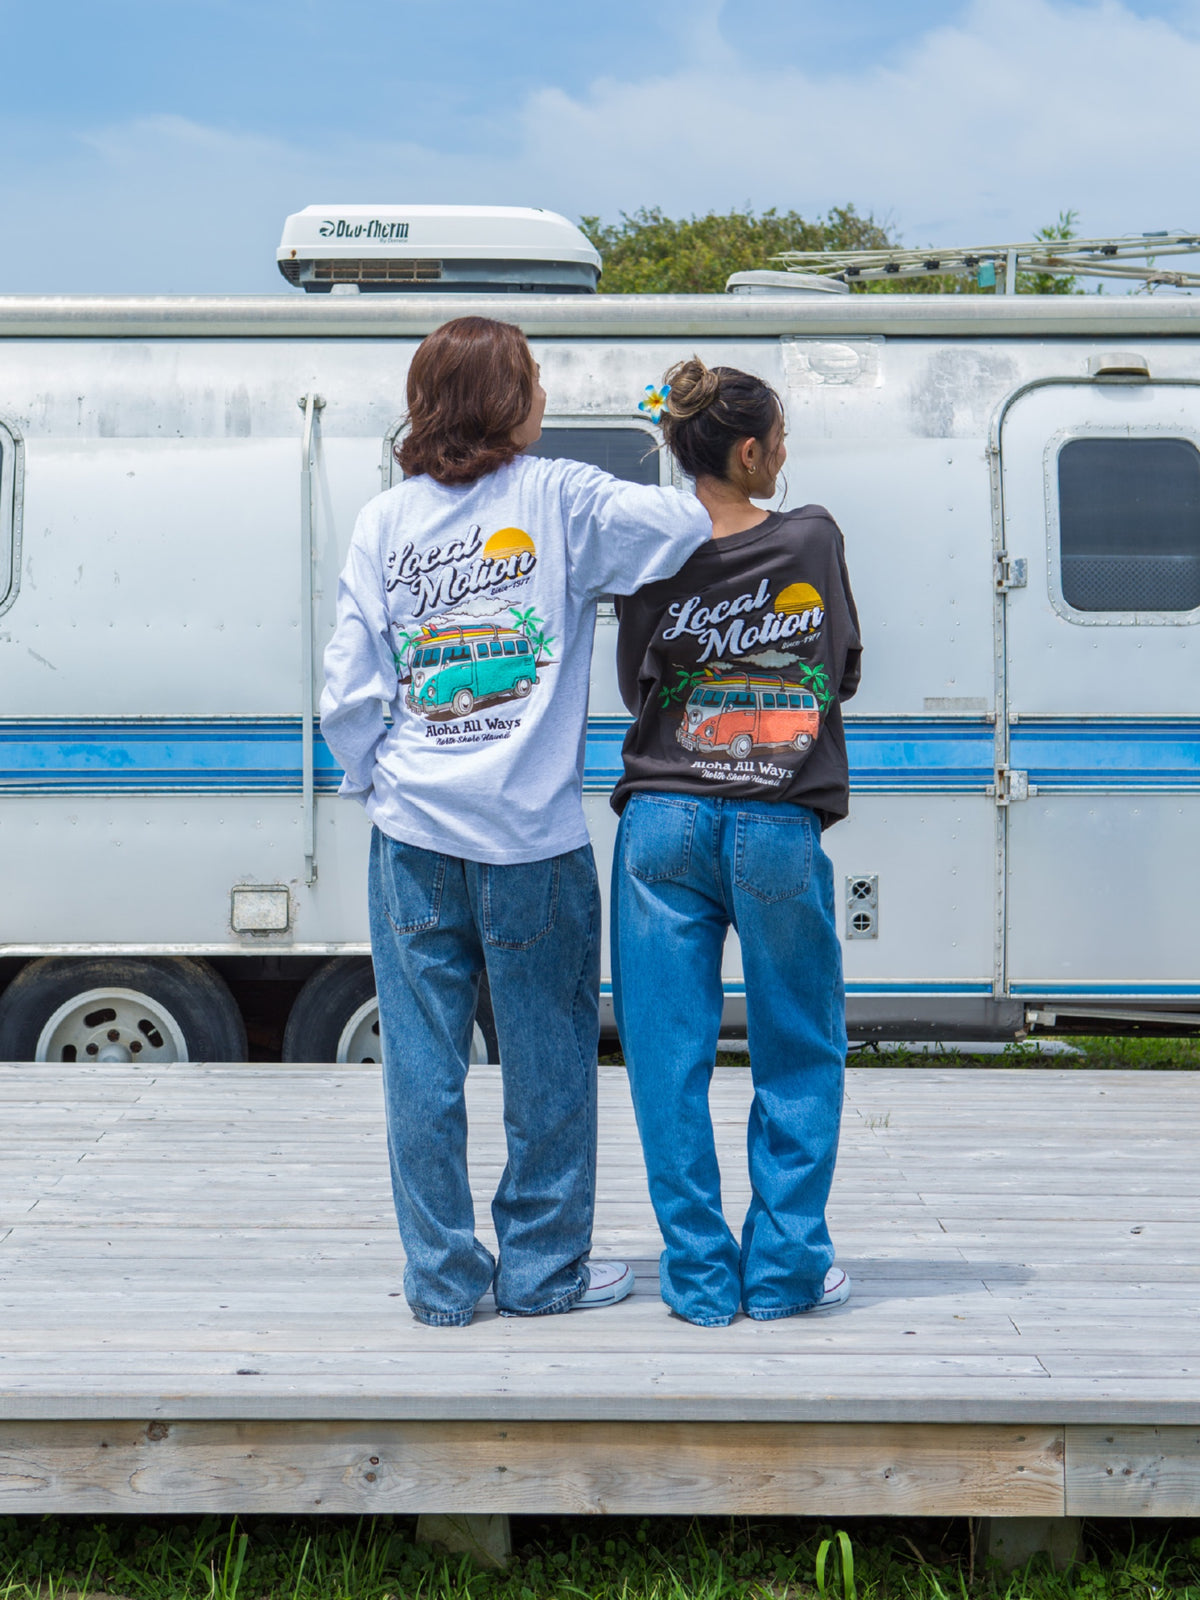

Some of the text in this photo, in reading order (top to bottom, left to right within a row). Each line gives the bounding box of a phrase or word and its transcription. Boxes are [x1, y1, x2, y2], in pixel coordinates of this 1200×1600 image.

[336, 219, 409, 238] Duo-Therm
[386, 525, 482, 592] Local
[410, 551, 537, 617] Motion
[662, 578, 771, 641] Local
[696, 606, 825, 663] Motion
[425, 717, 521, 738] Aloha All Ways
[436, 735, 456, 746] North
[457, 733, 480, 744] Shore
[690, 760, 794, 779] Aloha All Ways
[701, 768, 726, 781] North
[726, 772, 751, 782] Shore
